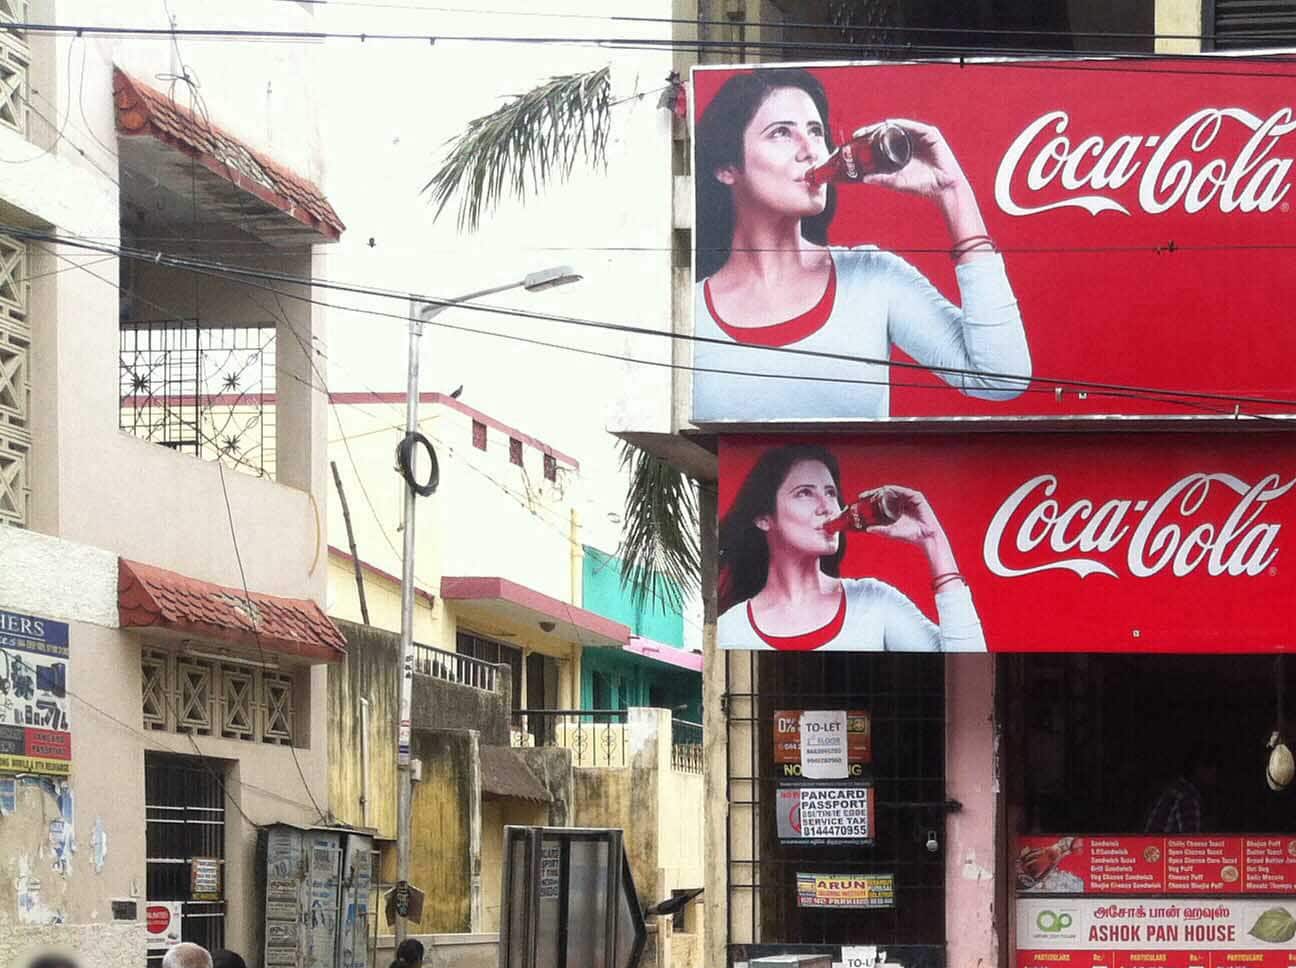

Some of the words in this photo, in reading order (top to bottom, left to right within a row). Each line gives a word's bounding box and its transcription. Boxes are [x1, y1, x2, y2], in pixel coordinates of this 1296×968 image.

[806, 722, 841, 732] TO-LET
[802, 790, 865, 801] PANCARD
[802, 800, 866, 810] PASSPORT
[817, 881, 866, 890] ARUN
[1088, 924, 1141, 942] ASHOK
[1147, 924, 1178, 941] PAN
[1185, 924, 1236, 941] HOUSE
